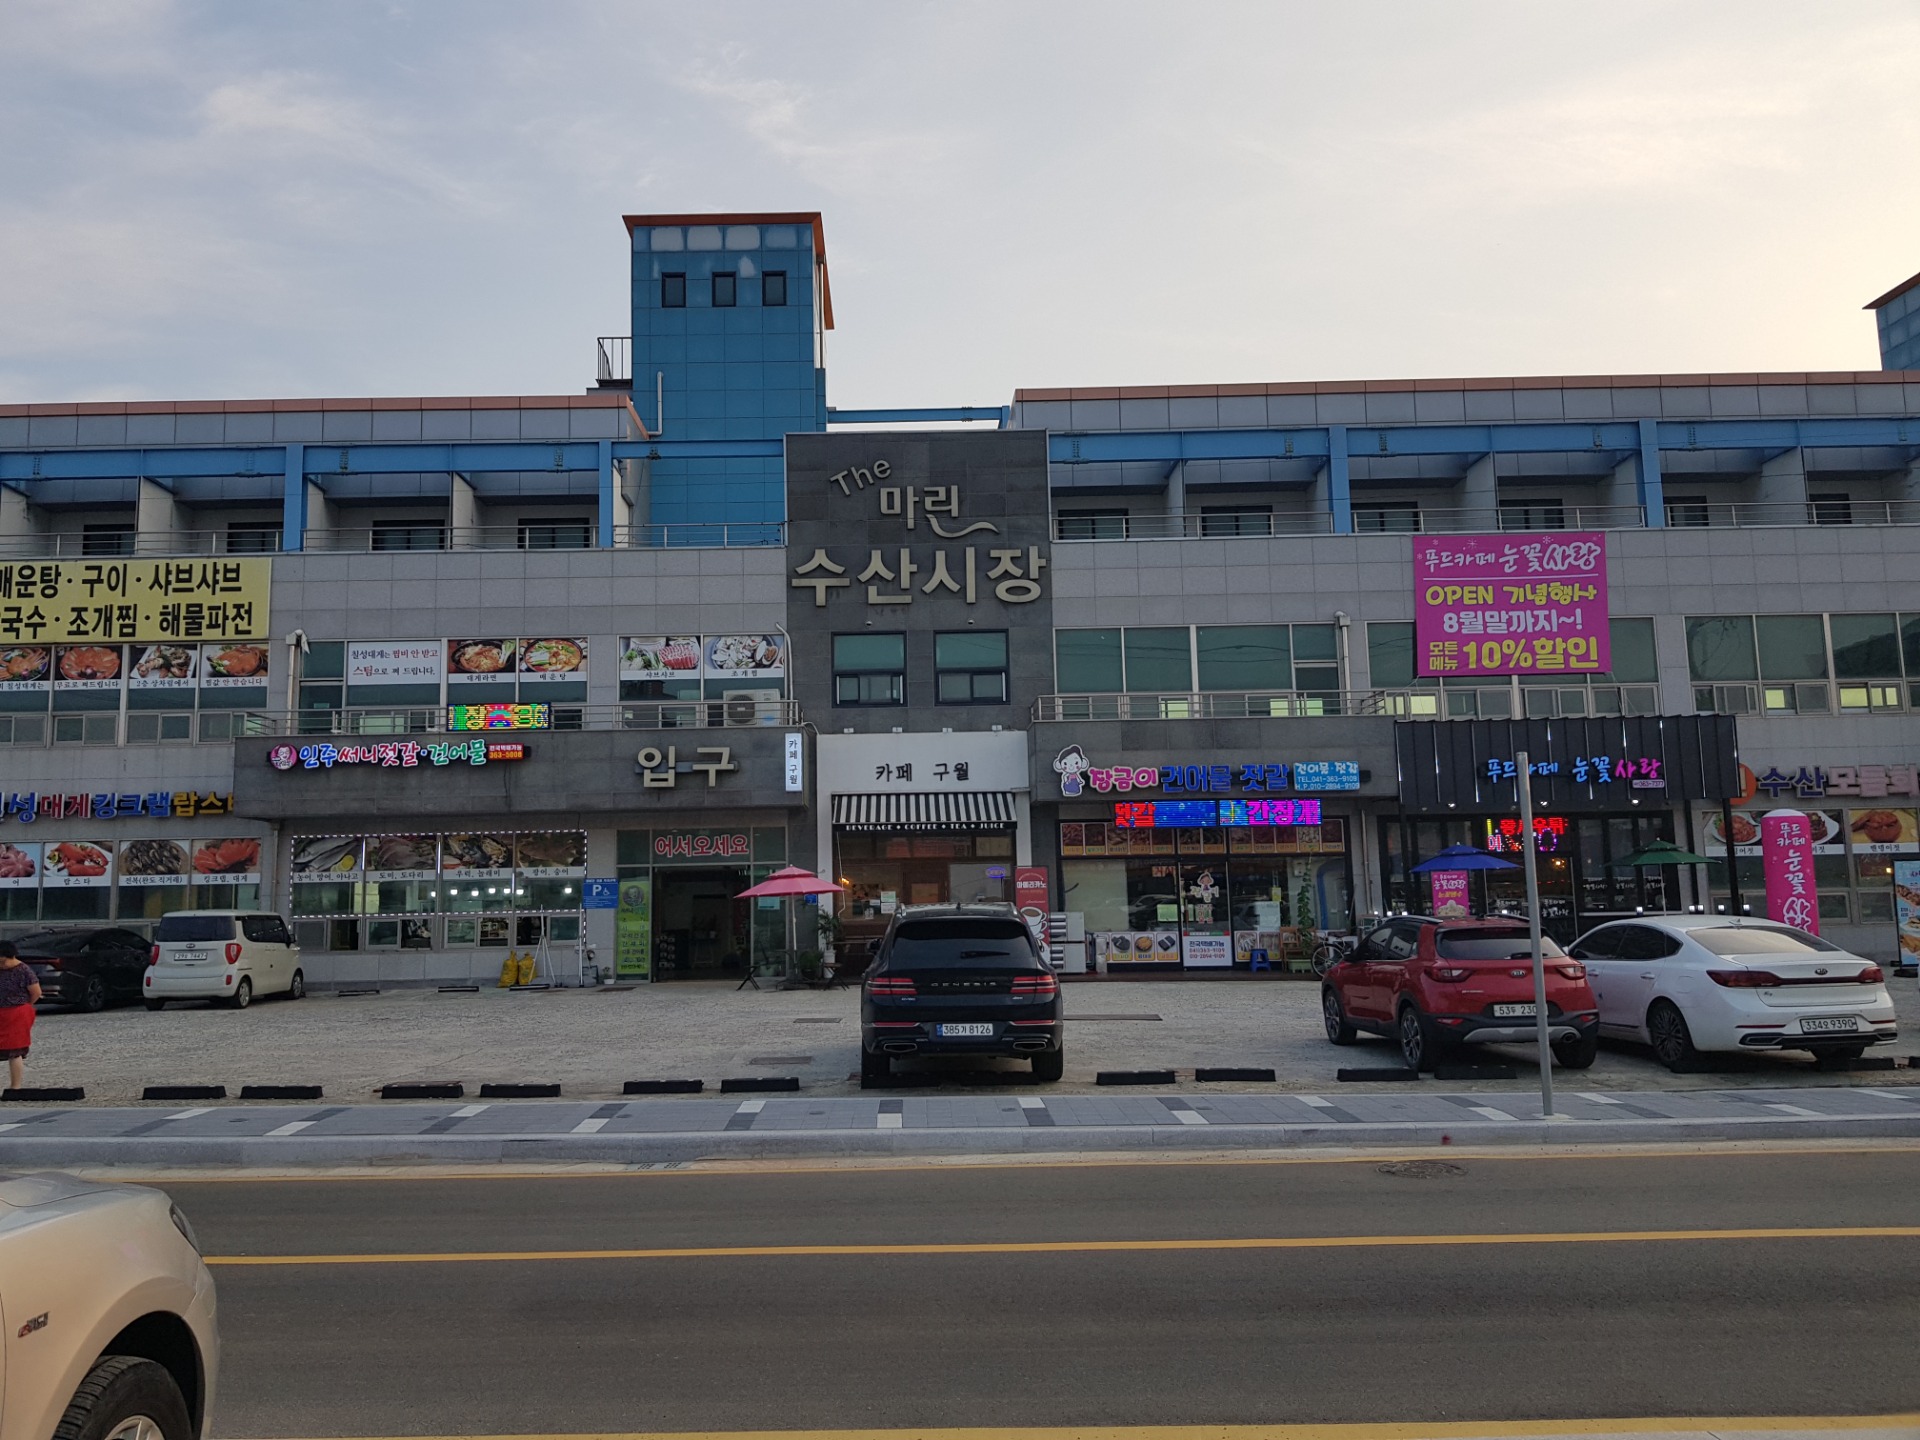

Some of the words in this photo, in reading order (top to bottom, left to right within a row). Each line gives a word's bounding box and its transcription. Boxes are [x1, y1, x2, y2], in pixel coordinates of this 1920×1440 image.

[829, 458, 892, 496] The
[879, 484, 999, 538] 마린
[1425, 548, 1495, 573] 푸드카페
[1498, 542, 1601, 573] 눈꽃사랑
[149, 562, 242, 597] 샤브샤브
[791, 545, 1048, 608] 수산시장
[1425, 584, 1494, 606] OPEN
[1502, 581, 1598, 606] 기념행사
[159, 601, 252, 637] 해물파전
[1443, 607, 1583, 635] 8월말까지~!
[411, 649, 420, 659] 안
[421, 648, 439, 659] 받고
[1429, 641, 1458, 656] 모든
[1429, 656, 1459, 671] 메뉴
[466, 674, 497, 682] 대게라면
[788, 739, 798, 760] 카페
[637, 745, 736, 788] 입구
[788, 765, 799, 785] 구월
[875, 762, 913, 782] 카페
[933, 761, 970, 781] 구월
[1088, 767, 1158, 794] 장금이
[1160, 764, 1232, 794] 건어물
[1240, 762, 1289, 792] 젓갈
[904, 823, 938, 831] COFFEE
[979, 822, 1005, 830] JUICE
[1779, 822, 1802, 840] 푸드
[654, 833, 750, 859] 어서오세요
[1776, 836, 1806, 848] 카페
[592, 884, 602, 896] P
[968, 1024, 991, 1034] 8126
